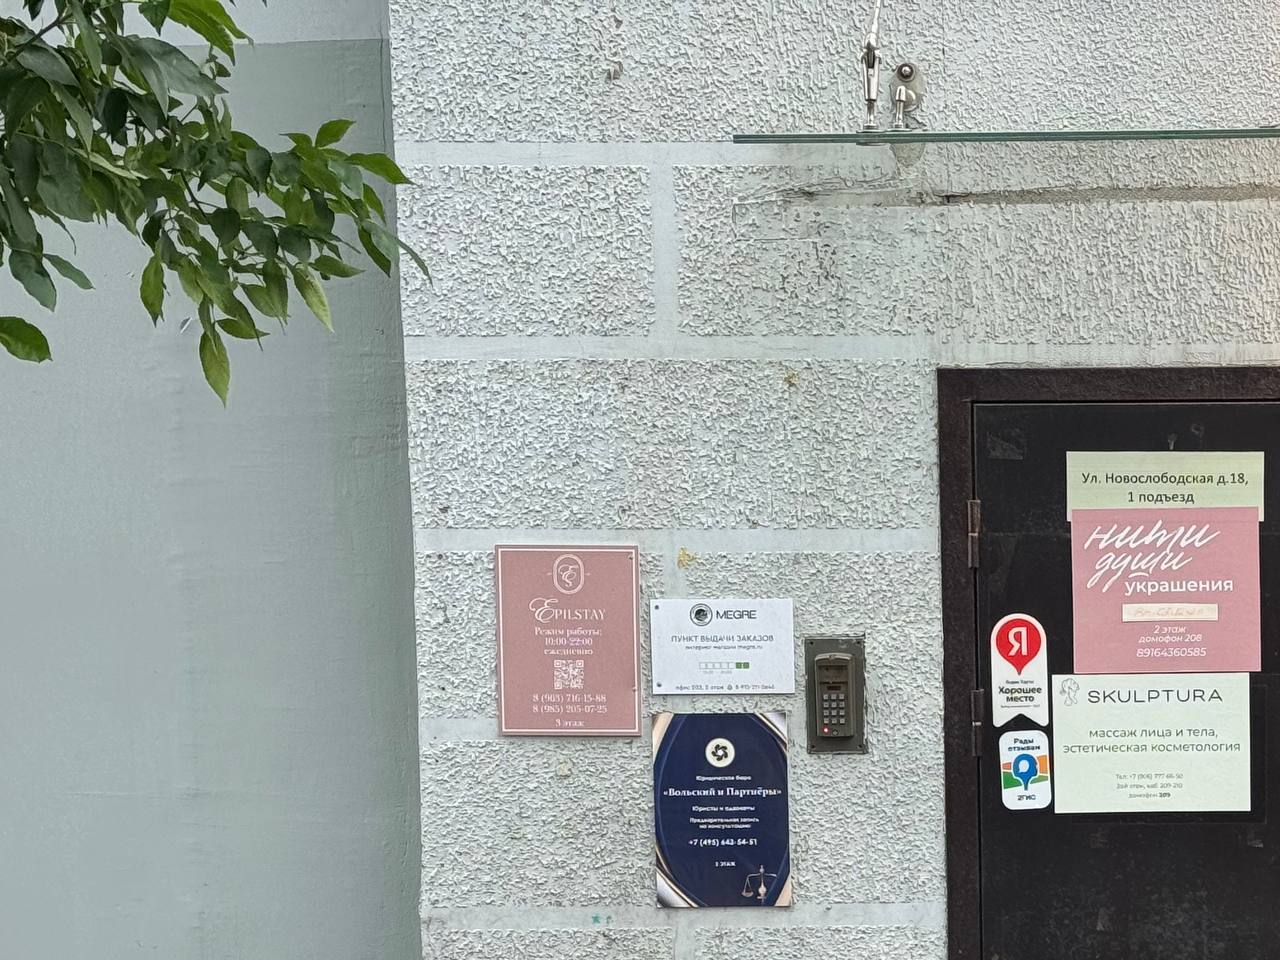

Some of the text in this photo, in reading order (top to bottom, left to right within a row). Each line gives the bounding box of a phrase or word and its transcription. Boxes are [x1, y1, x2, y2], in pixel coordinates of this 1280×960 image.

[1081, 472, 1249, 486] Ул. Новослободская д.18,
[1127, 492, 1195, 505] 1 подъезд
[1125, 579, 1233, 596] украшения
[716, 610, 757, 620] MEGRE
[1153, 625, 1187, 634] 2 этаж
[671, 634, 775, 643] ПУНКТ ВЫДАЧИ ЗАКАЗОВ
[1008, 627, 1028, 656] Я
[1138, 635, 1183, 644] домофон
[998, 686, 1042, 695] Хорошее
[1087, 689, 1223, 704] SKULPTURA
[1089, 727, 1218, 739] массаж лица и тела,
[1063, 742, 1241, 753] эстетическая косметология
[663, 787, 716, 797] «Вольский
[726, 787, 782, 798] Партнёры»
